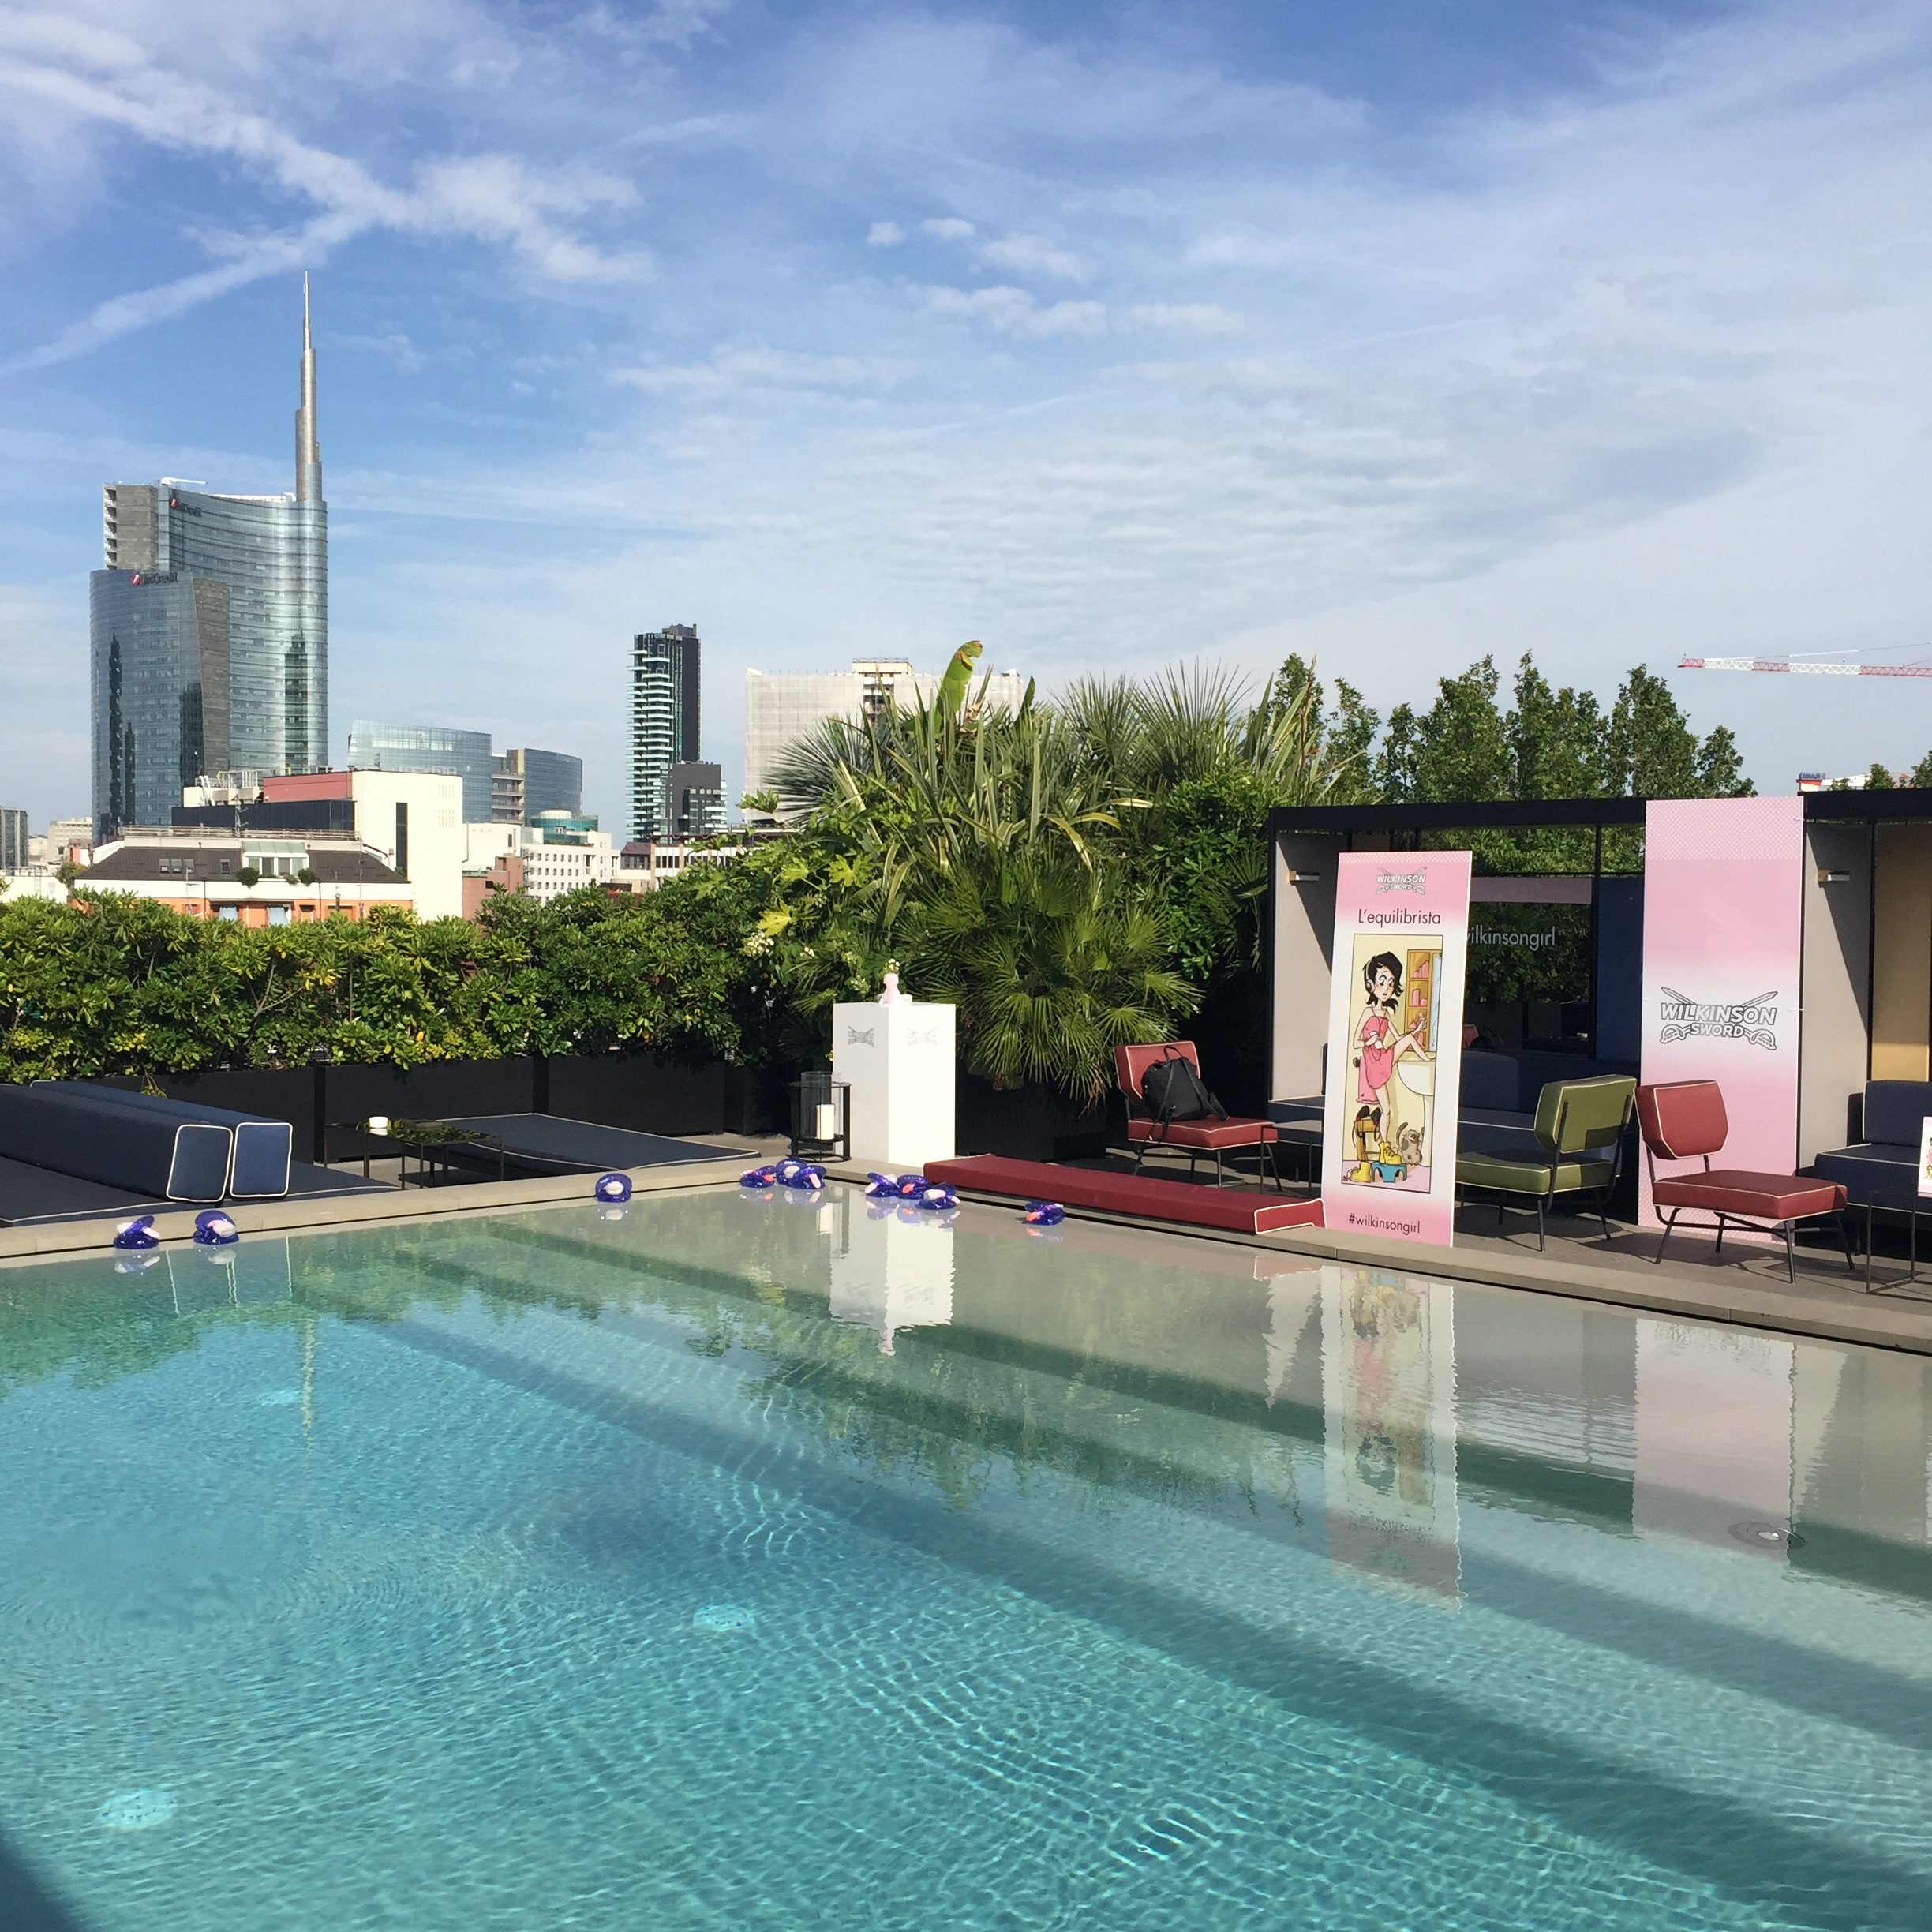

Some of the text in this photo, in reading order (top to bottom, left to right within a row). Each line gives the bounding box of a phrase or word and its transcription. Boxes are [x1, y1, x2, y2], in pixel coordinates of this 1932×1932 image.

[1376, 874, 1426, 884] WILKINSON
[1358, 908, 1441, 928] L'equilibrista
[1467, 924, 1556, 951] ilkinsongirl
[1661, 1002, 1777, 1025] WILKINSON
[1690, 1022, 1745, 1038] SWORD
[1349, 1213, 1421, 1235] #wilkinsongirl
